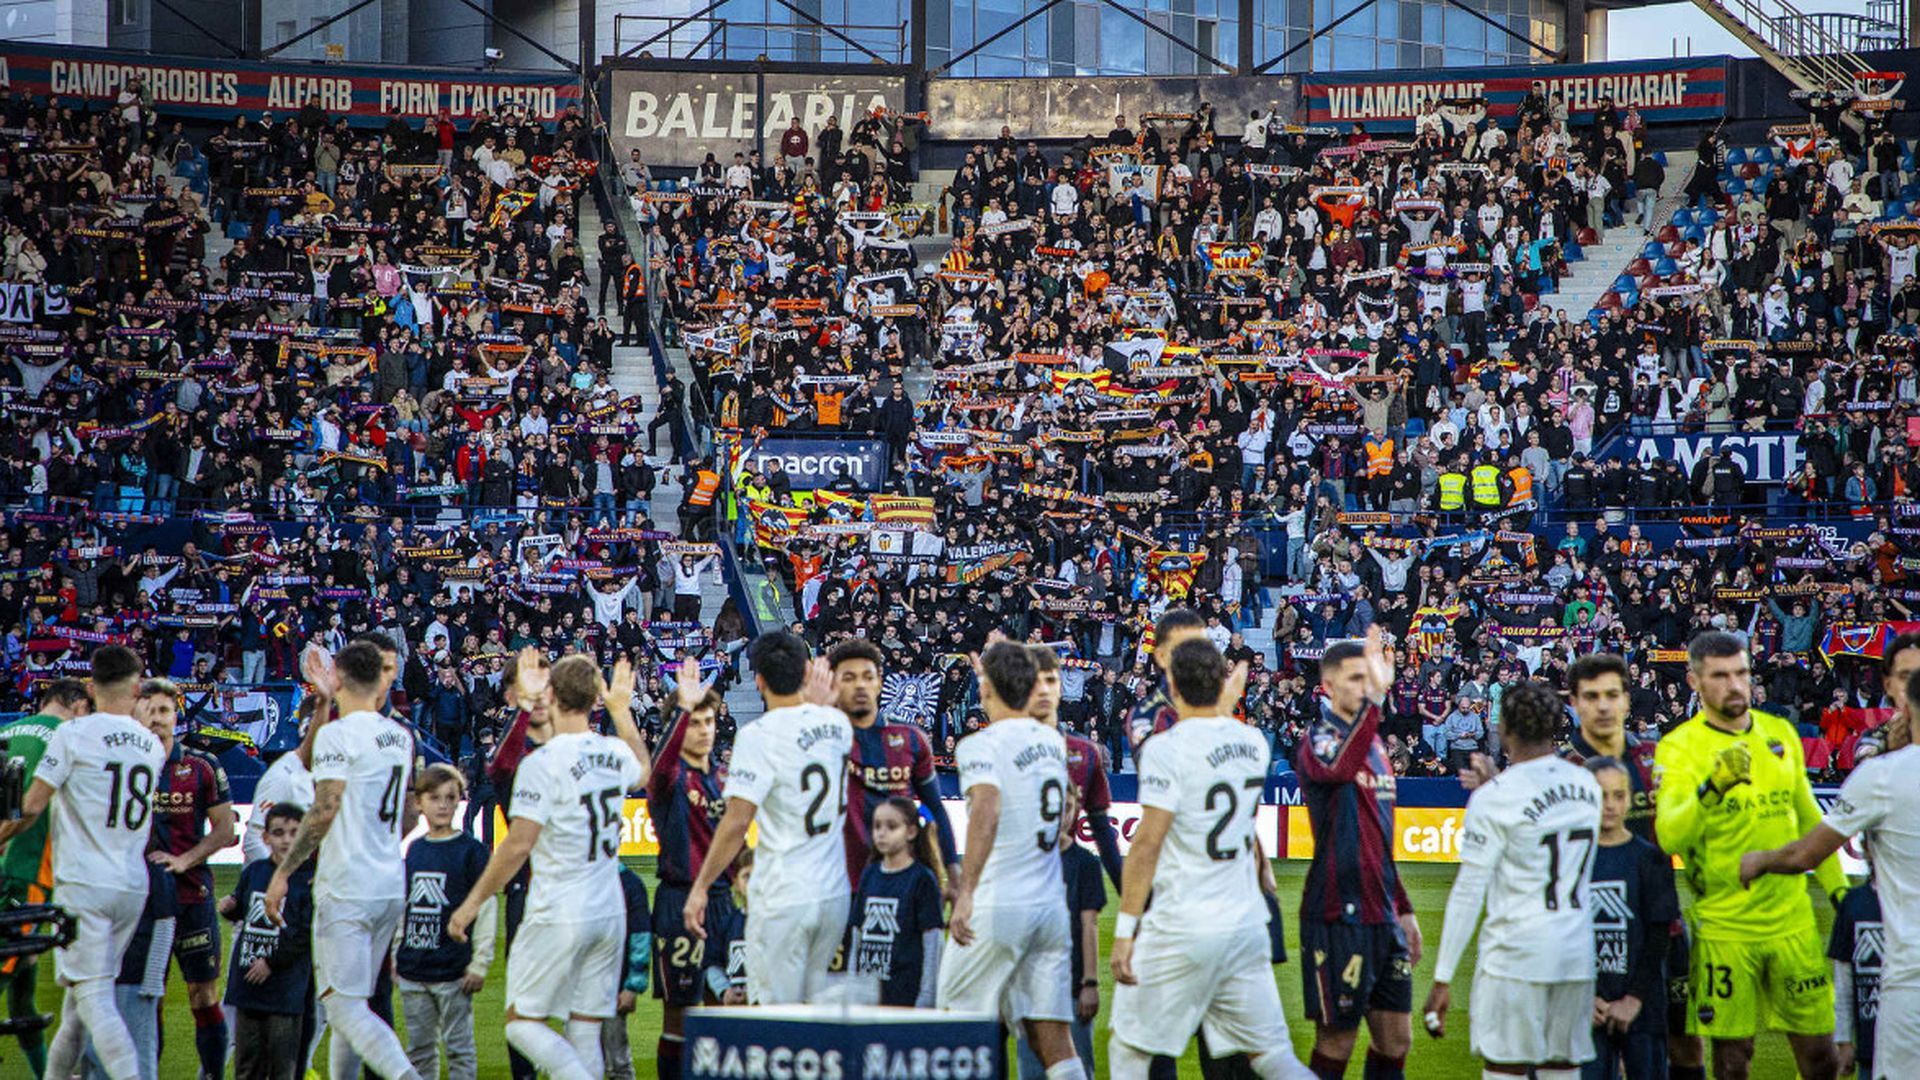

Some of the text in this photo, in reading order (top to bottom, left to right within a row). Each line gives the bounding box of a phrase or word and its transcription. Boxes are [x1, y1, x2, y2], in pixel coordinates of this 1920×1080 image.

[268, 76, 352, 111] ALFARB
[380, 80, 439, 114] FORN
[1037, 246, 1077, 257] AMUNT
[758, 456, 864, 475] macron
[407, 550, 440, 558] LEVANTE
[947, 541, 1006, 561] VALENCIA
[1717, 591, 1752, 599] LEVANTE
[103, 733, 152, 755] PEPELU
[104, 761, 154, 831] 18
[379, 765, 404, 835] 4
[580, 786, 622, 861] 15
[1036, 778, 1063, 854] 9
[1539, 831, 1594, 911] 17
[405, 936, 442, 951] HOME
[671, 935, 705, 969] 24
[1341, 953, 1364, 989] 4
[1703, 962, 1735, 998] 13
[692, 1036, 844, 1080] MARCOS
[861, 1040, 994, 1080] MARCOS
